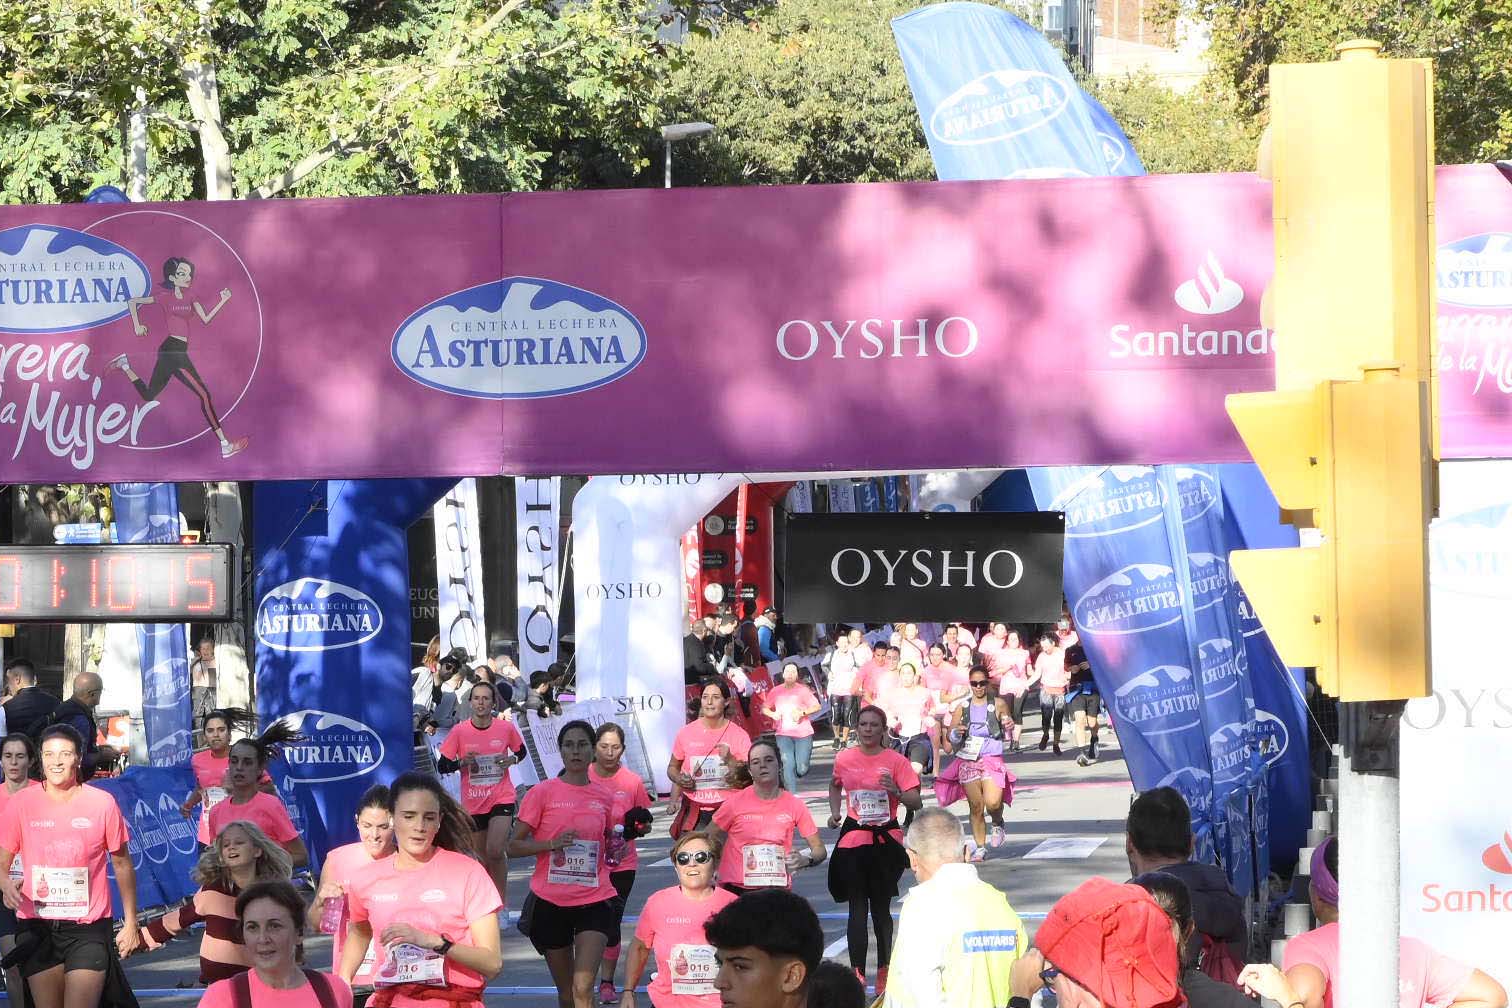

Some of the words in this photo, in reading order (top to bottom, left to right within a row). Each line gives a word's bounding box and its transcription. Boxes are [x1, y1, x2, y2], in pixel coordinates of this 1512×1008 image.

[54, 260, 126, 272] LECHERA
[450, 319, 530, 333] CENTRAL
[538, 317, 619, 331] LECHERA
[775, 316, 980, 361] OYSHO
[411, 325, 627, 369] ASTURIANA
[11, 375, 161, 470] Mujer
[830, 548, 1025, 590] OYSHO
[585, 582, 663, 600] OYSHO
[319, 602, 369, 611] LECHERA
[260, 607, 374, 636] ASTURIANA
[567, 857, 586, 866] 016
[50, 887, 70, 895] 016
[963, 935, 1016, 949] VOLUNTARIS
[398, 963, 419, 974] 016
[689, 963, 710, 973] 016
